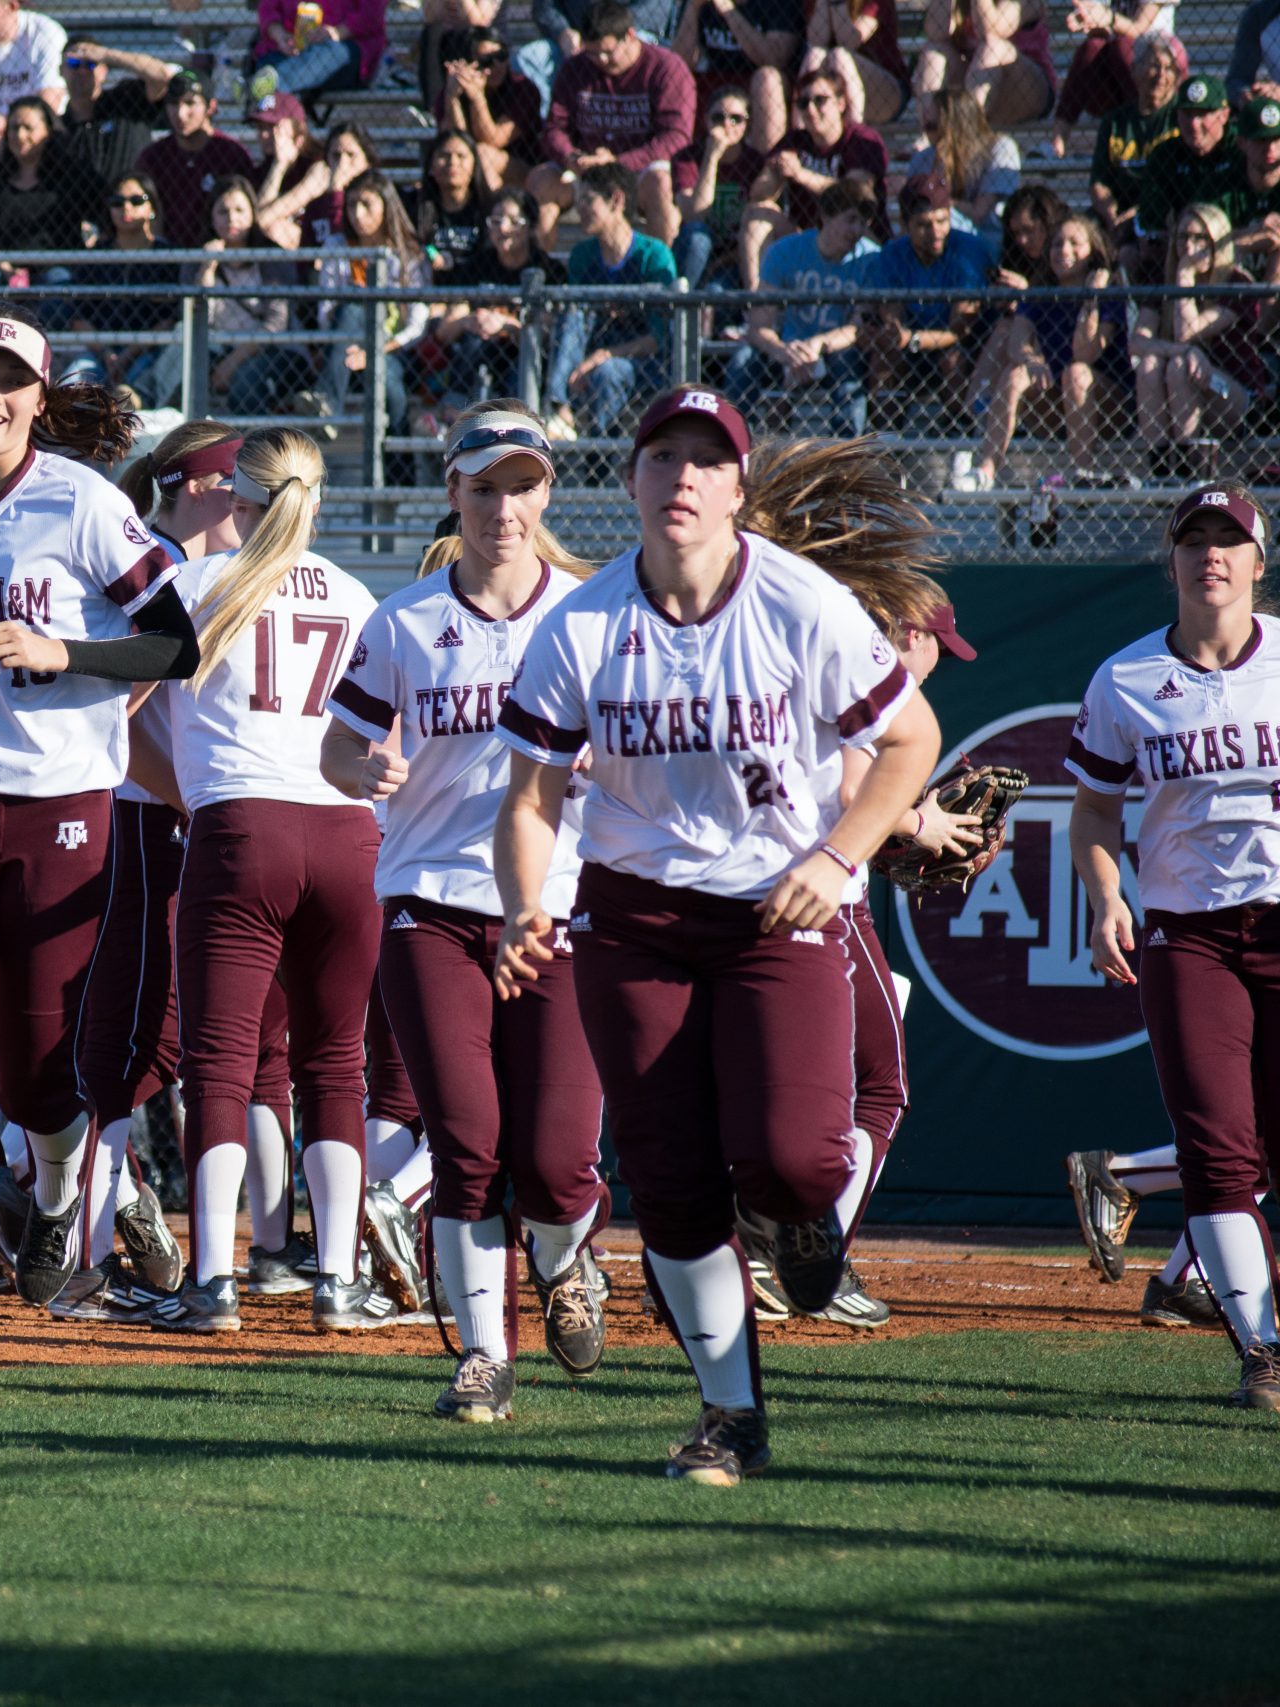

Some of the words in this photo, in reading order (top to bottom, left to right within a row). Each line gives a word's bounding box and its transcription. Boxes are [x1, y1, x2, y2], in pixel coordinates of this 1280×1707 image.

[249, 609, 350, 718] 17
[598, 697, 712, 757] TEXAS
[725, 690, 790, 752] A&M
[1144, 724, 1246, 781] TEXAS
